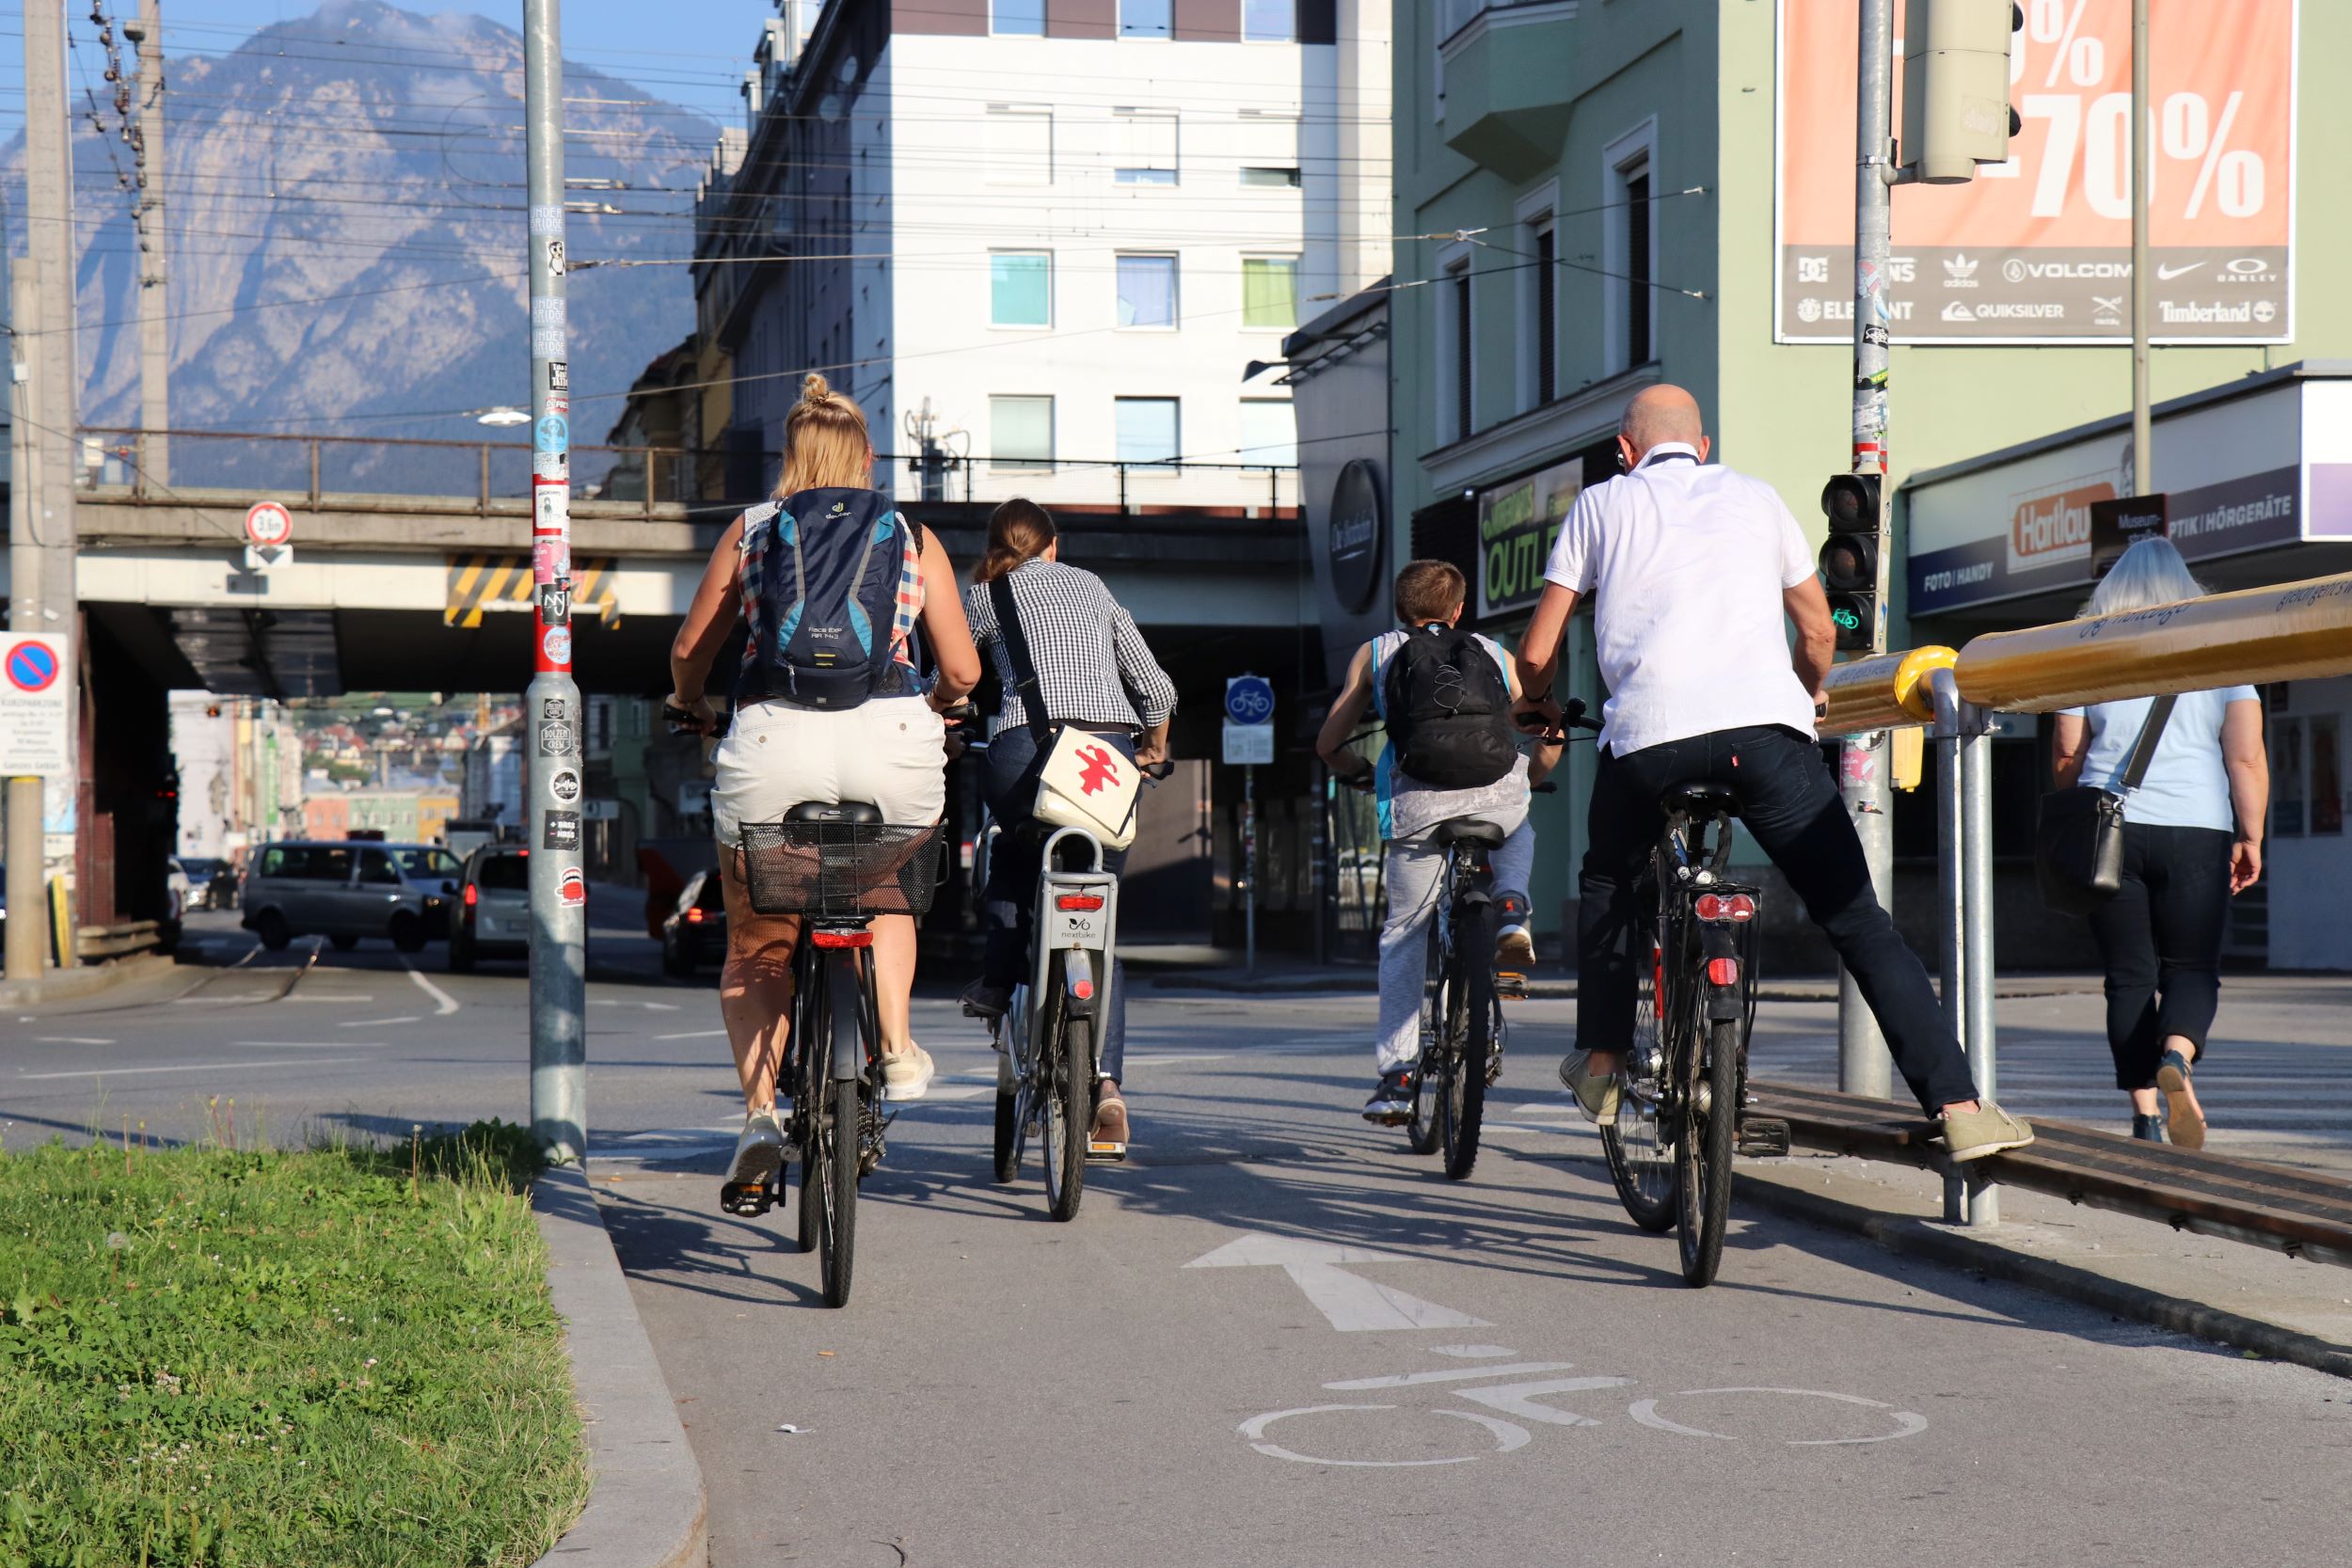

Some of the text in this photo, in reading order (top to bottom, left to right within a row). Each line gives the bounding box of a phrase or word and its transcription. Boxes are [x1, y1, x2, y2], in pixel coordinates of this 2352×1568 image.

[2026, 263, 2135, 278] VOLCOM
[1943, 278, 1979, 288] adidas
[2217, 274, 2278, 282] OAKLEY
[1823, 301, 1915, 320] ELENT
[1977, 304, 2064, 318] QUIKSILVER
[2158, 300, 2250, 323] Timberland
[825, 511, 851, 520] deuter
[2021, 496, 2091, 553] Hartlau
[2168, 516, 2199, 542] PTIK
[1924, 561, 1994, 593] FOTO HANDY
[545, 729, 568, 738] BOLZEN
[548, 740, 564, 750] CREW
[1061, 930, 1097, 939] nextbike
